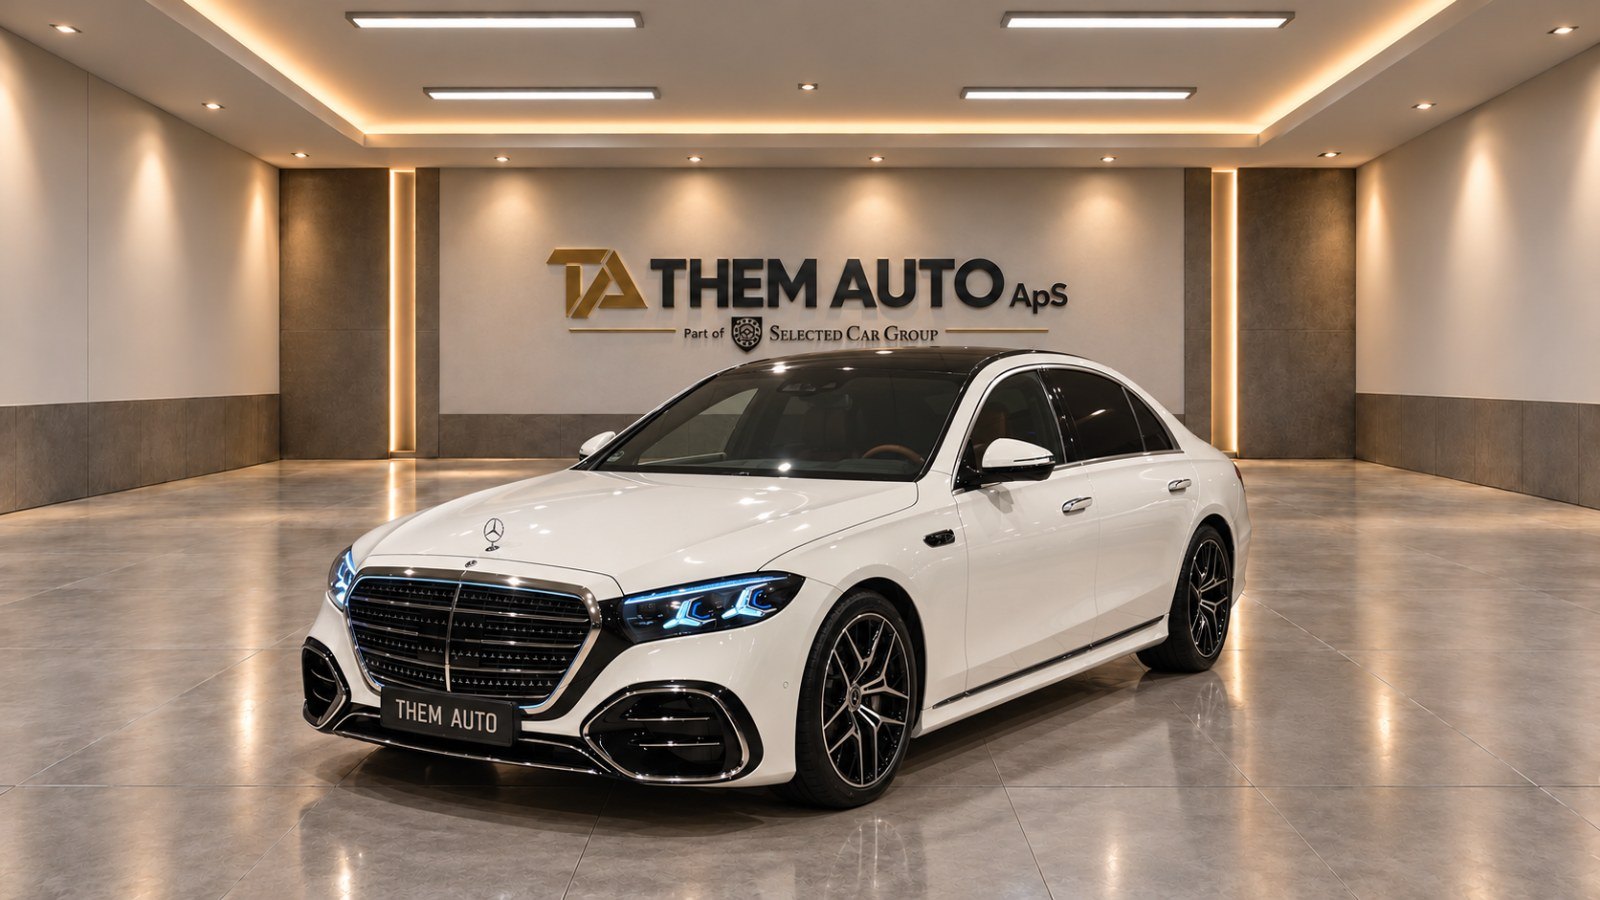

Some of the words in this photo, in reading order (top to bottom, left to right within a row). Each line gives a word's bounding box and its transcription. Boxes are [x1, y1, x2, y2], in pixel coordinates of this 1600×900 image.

[650, 258, 817, 309] THEM
[830, 258, 1005, 309] AUTO
[1010, 282, 1068, 314] ApS
[684, 328, 709, 339] Part
[712, 327, 725, 339] of
[395, 698, 442, 726] THEM
[450, 708, 498, 733] AUTO
